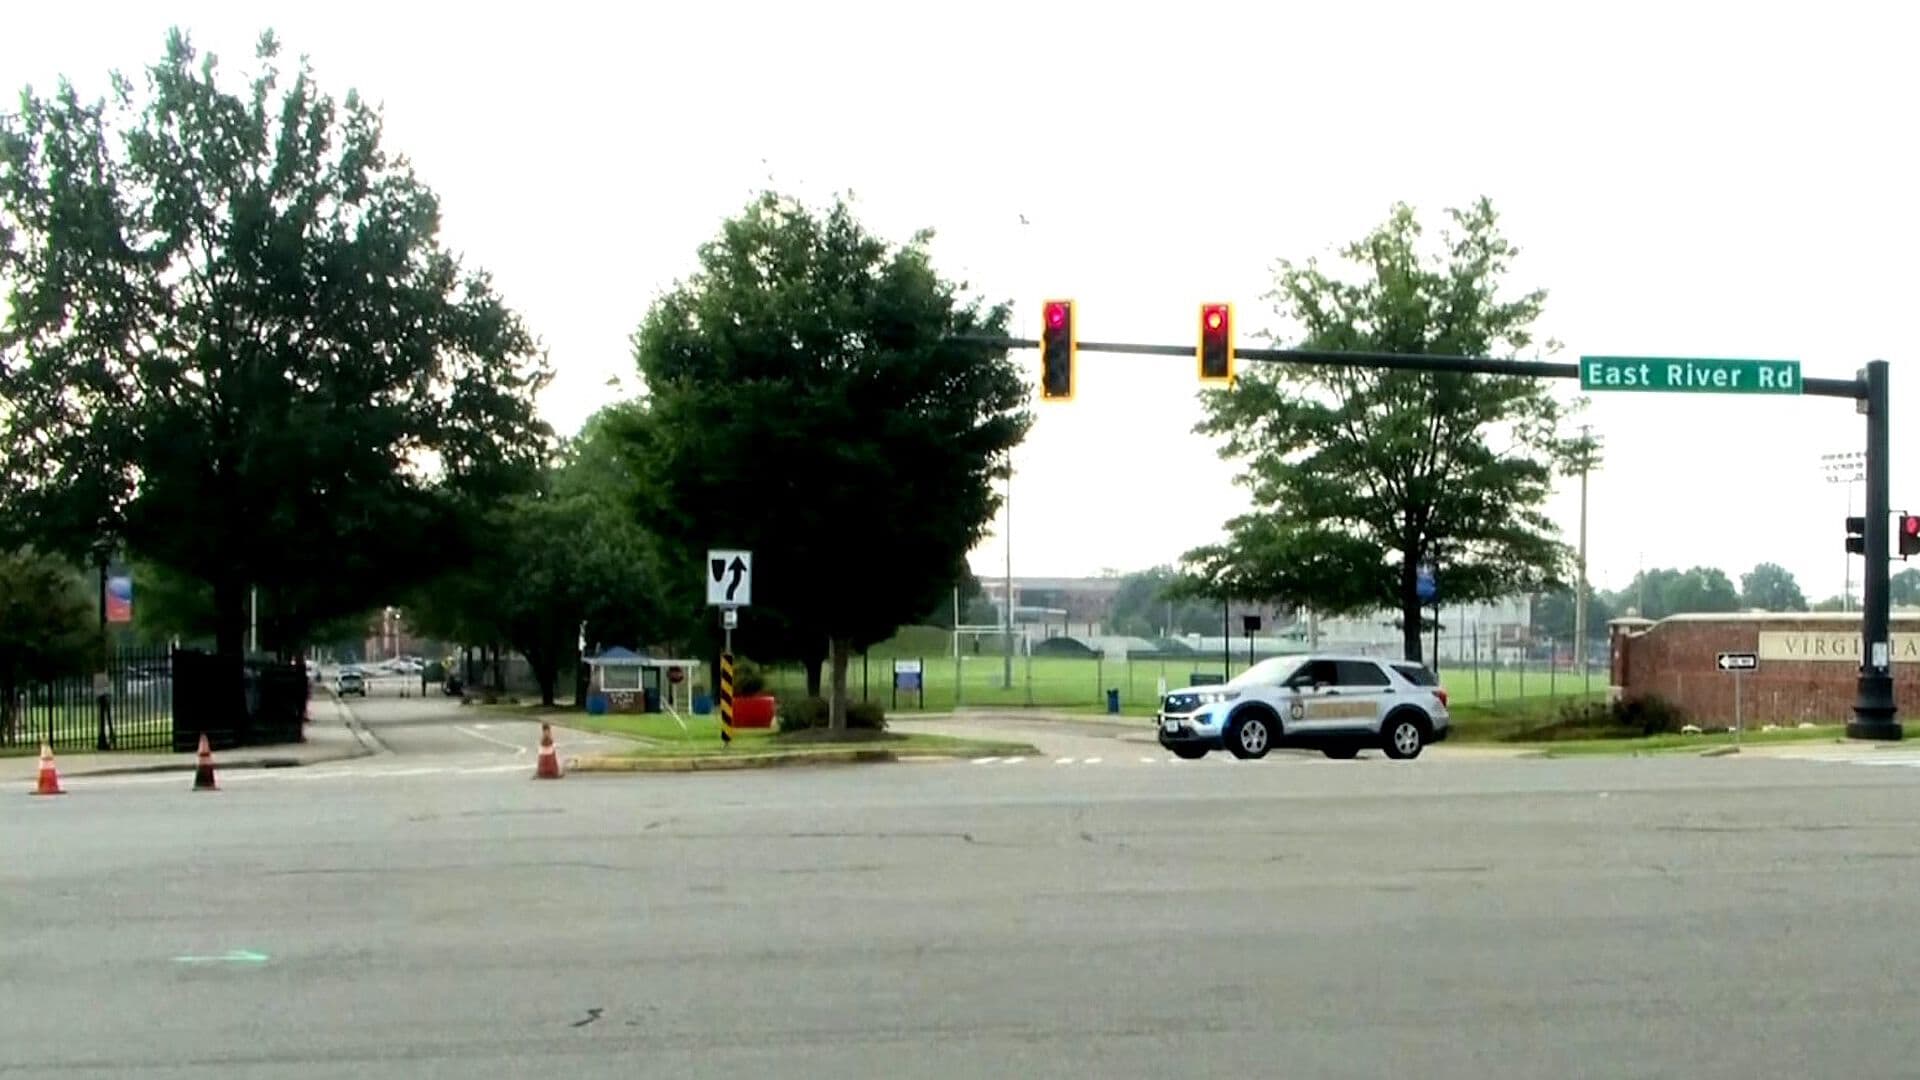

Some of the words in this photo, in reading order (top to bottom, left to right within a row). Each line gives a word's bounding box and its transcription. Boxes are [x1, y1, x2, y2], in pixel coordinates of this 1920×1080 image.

[1588, 363, 1650, 385] East
[1667, 364, 1742, 387] River
[1758, 365, 1793, 388] Rd
[1785, 639, 1917, 655] VIRGIIA
